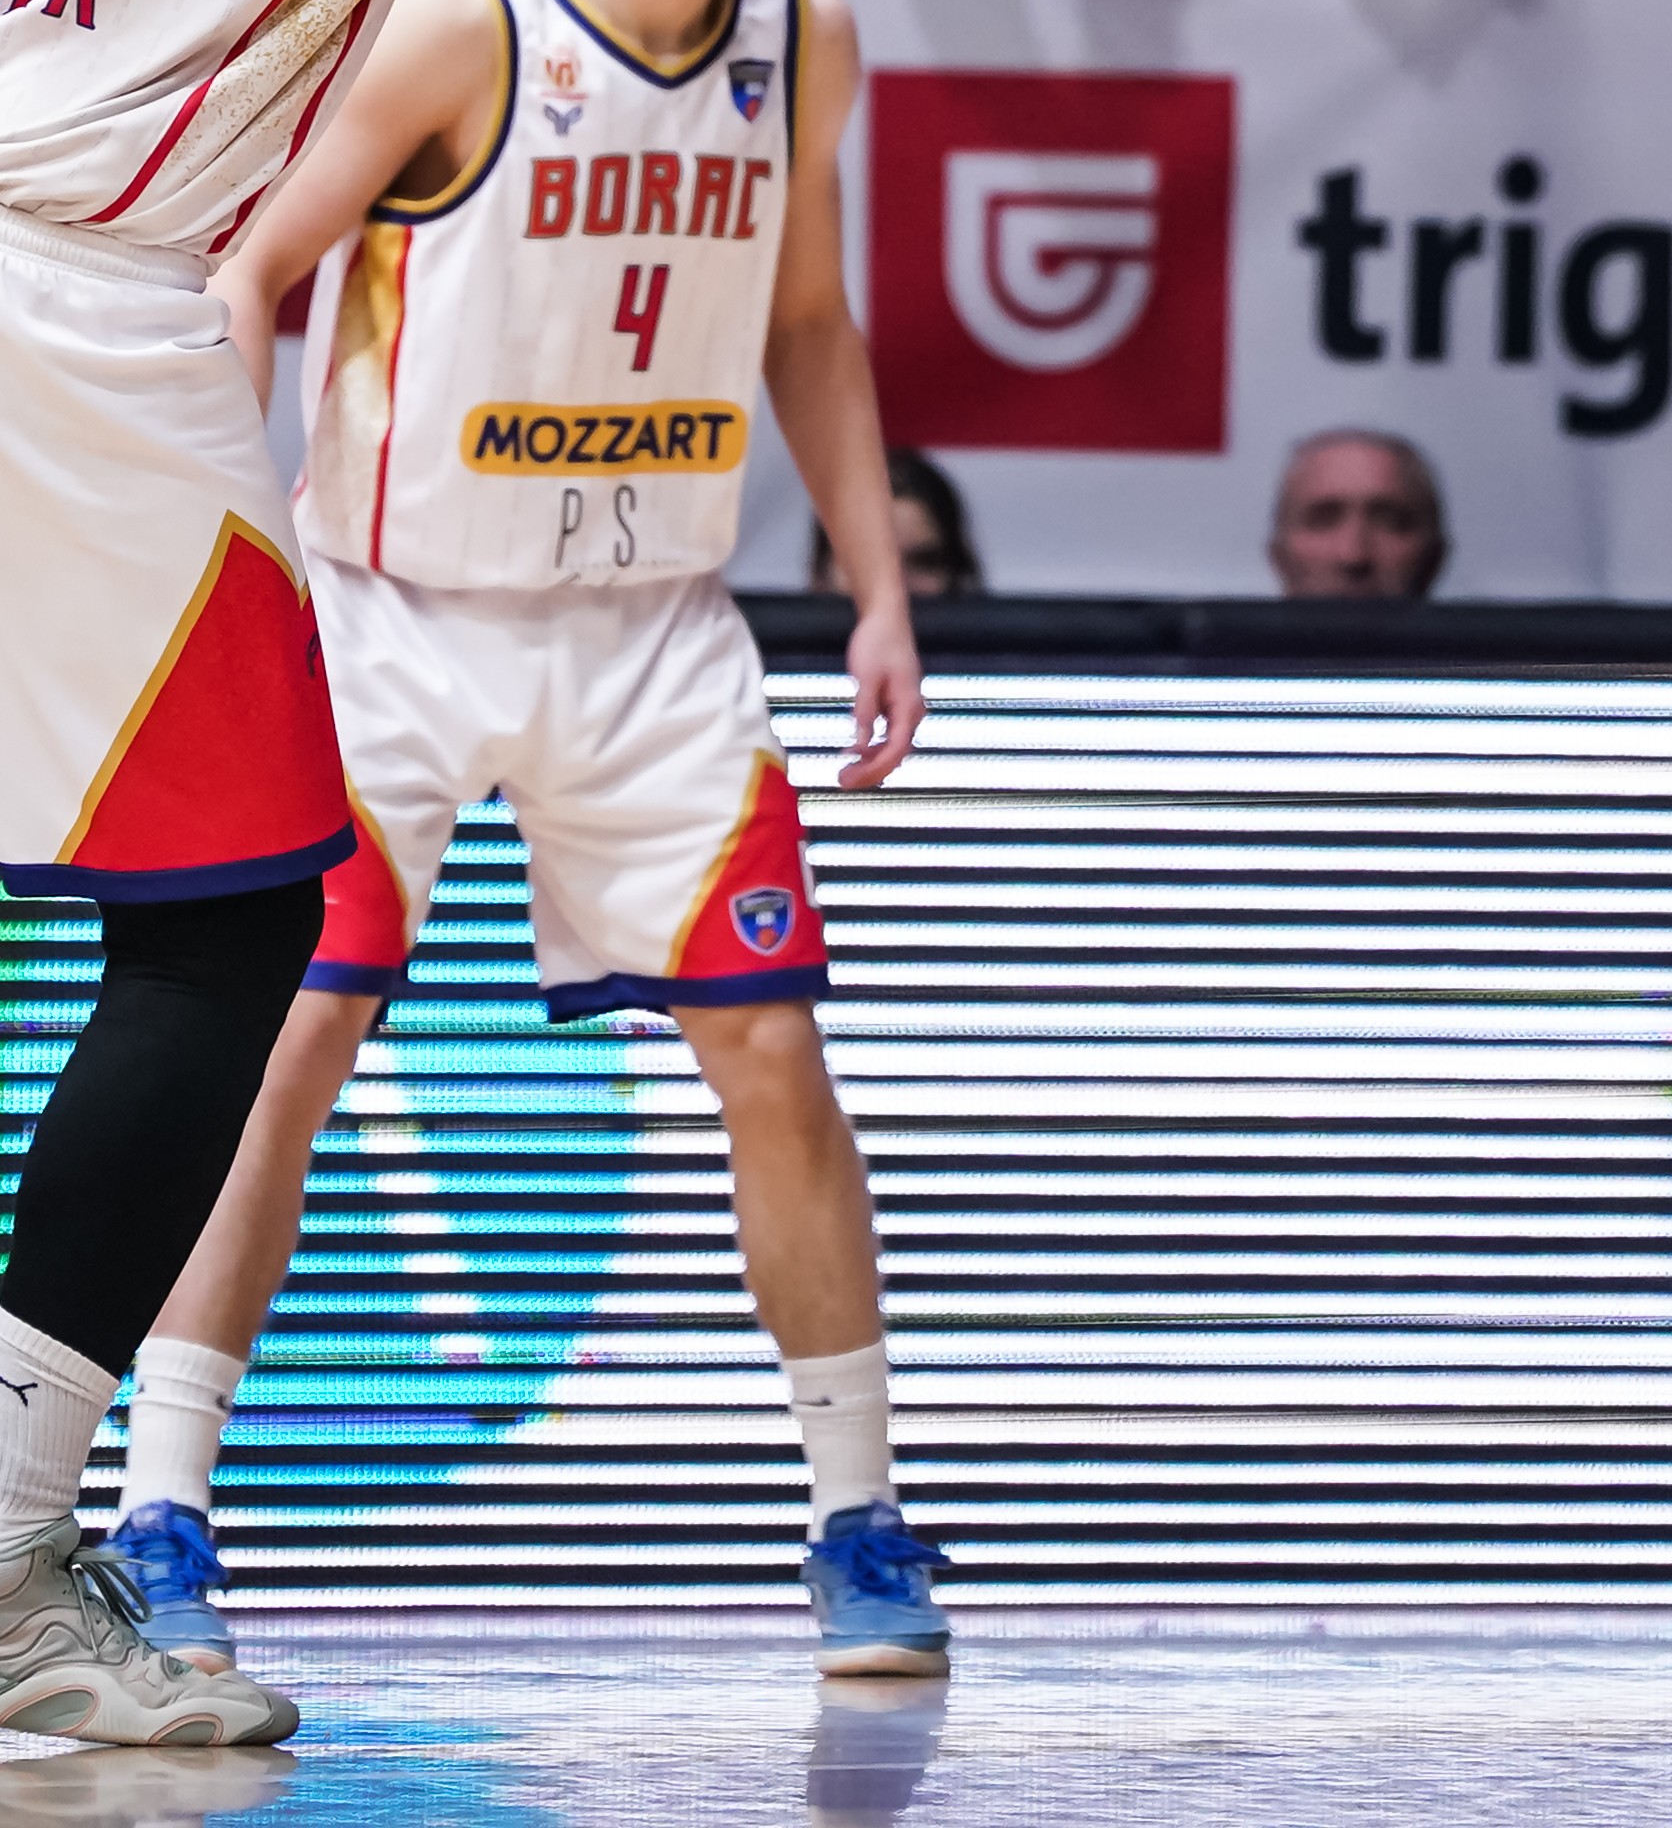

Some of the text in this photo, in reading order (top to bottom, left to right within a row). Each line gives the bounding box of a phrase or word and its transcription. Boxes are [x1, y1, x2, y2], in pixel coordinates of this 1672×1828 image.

[524, 151, 772, 239] BORAC
[612, 264, 671, 372] 4
[474, 412, 735, 464] MOZZART
